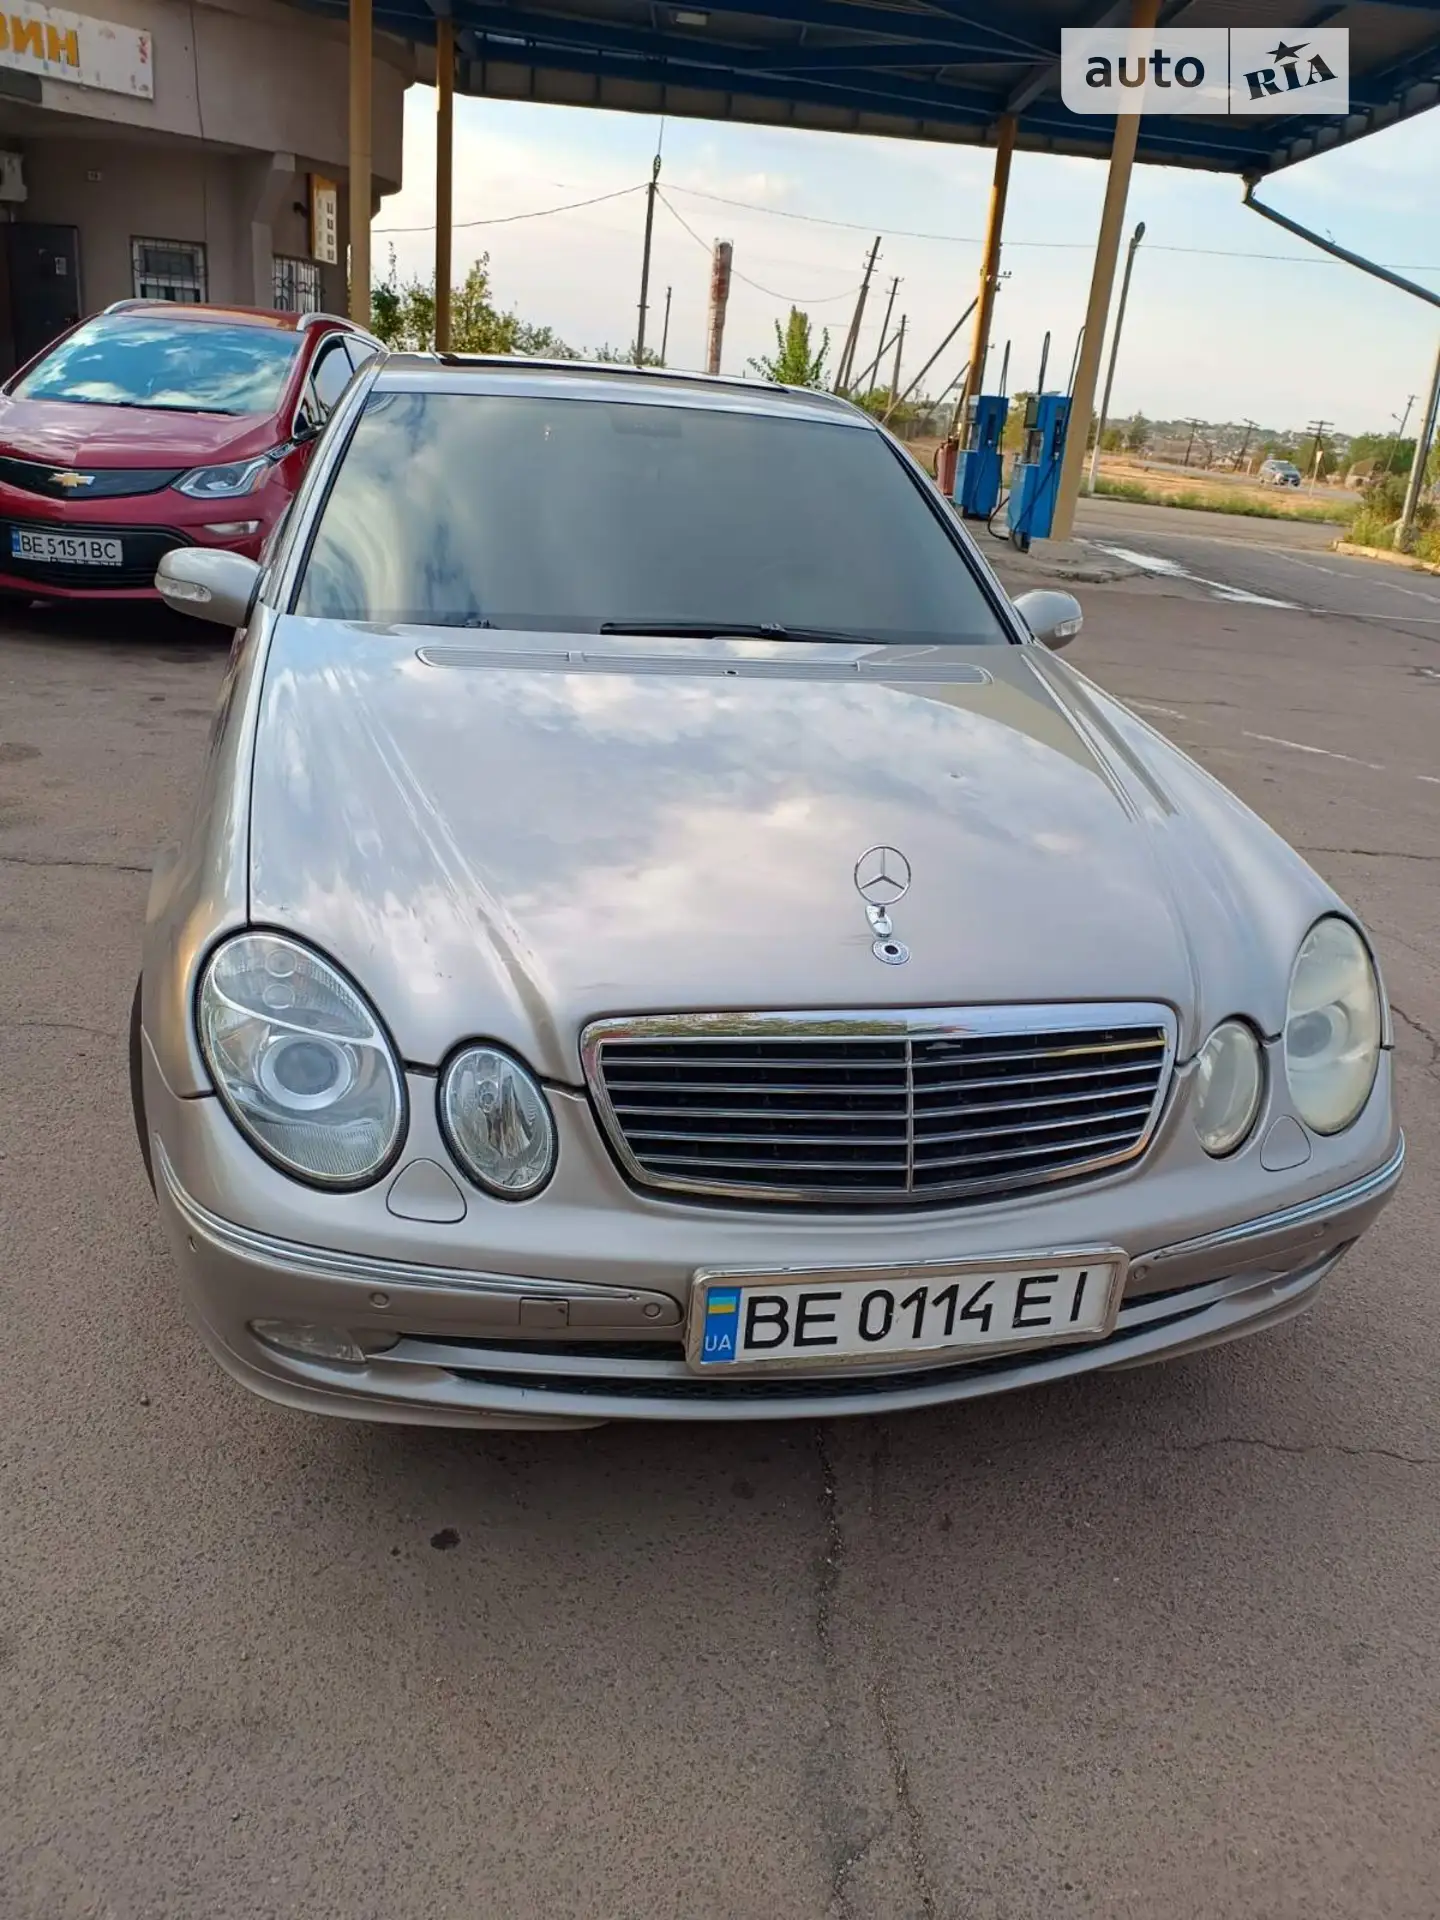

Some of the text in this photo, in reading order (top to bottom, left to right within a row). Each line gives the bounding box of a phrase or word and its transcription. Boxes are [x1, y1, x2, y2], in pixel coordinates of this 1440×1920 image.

[21, 535, 44, 555] BE
[47, 538, 87, 558] 5151
[91, 541, 116, 559] BC
[743, 1291, 842, 1350] BE
[858, 1280, 996, 1343] 0114
[705, 1333, 732, 1351] UA
